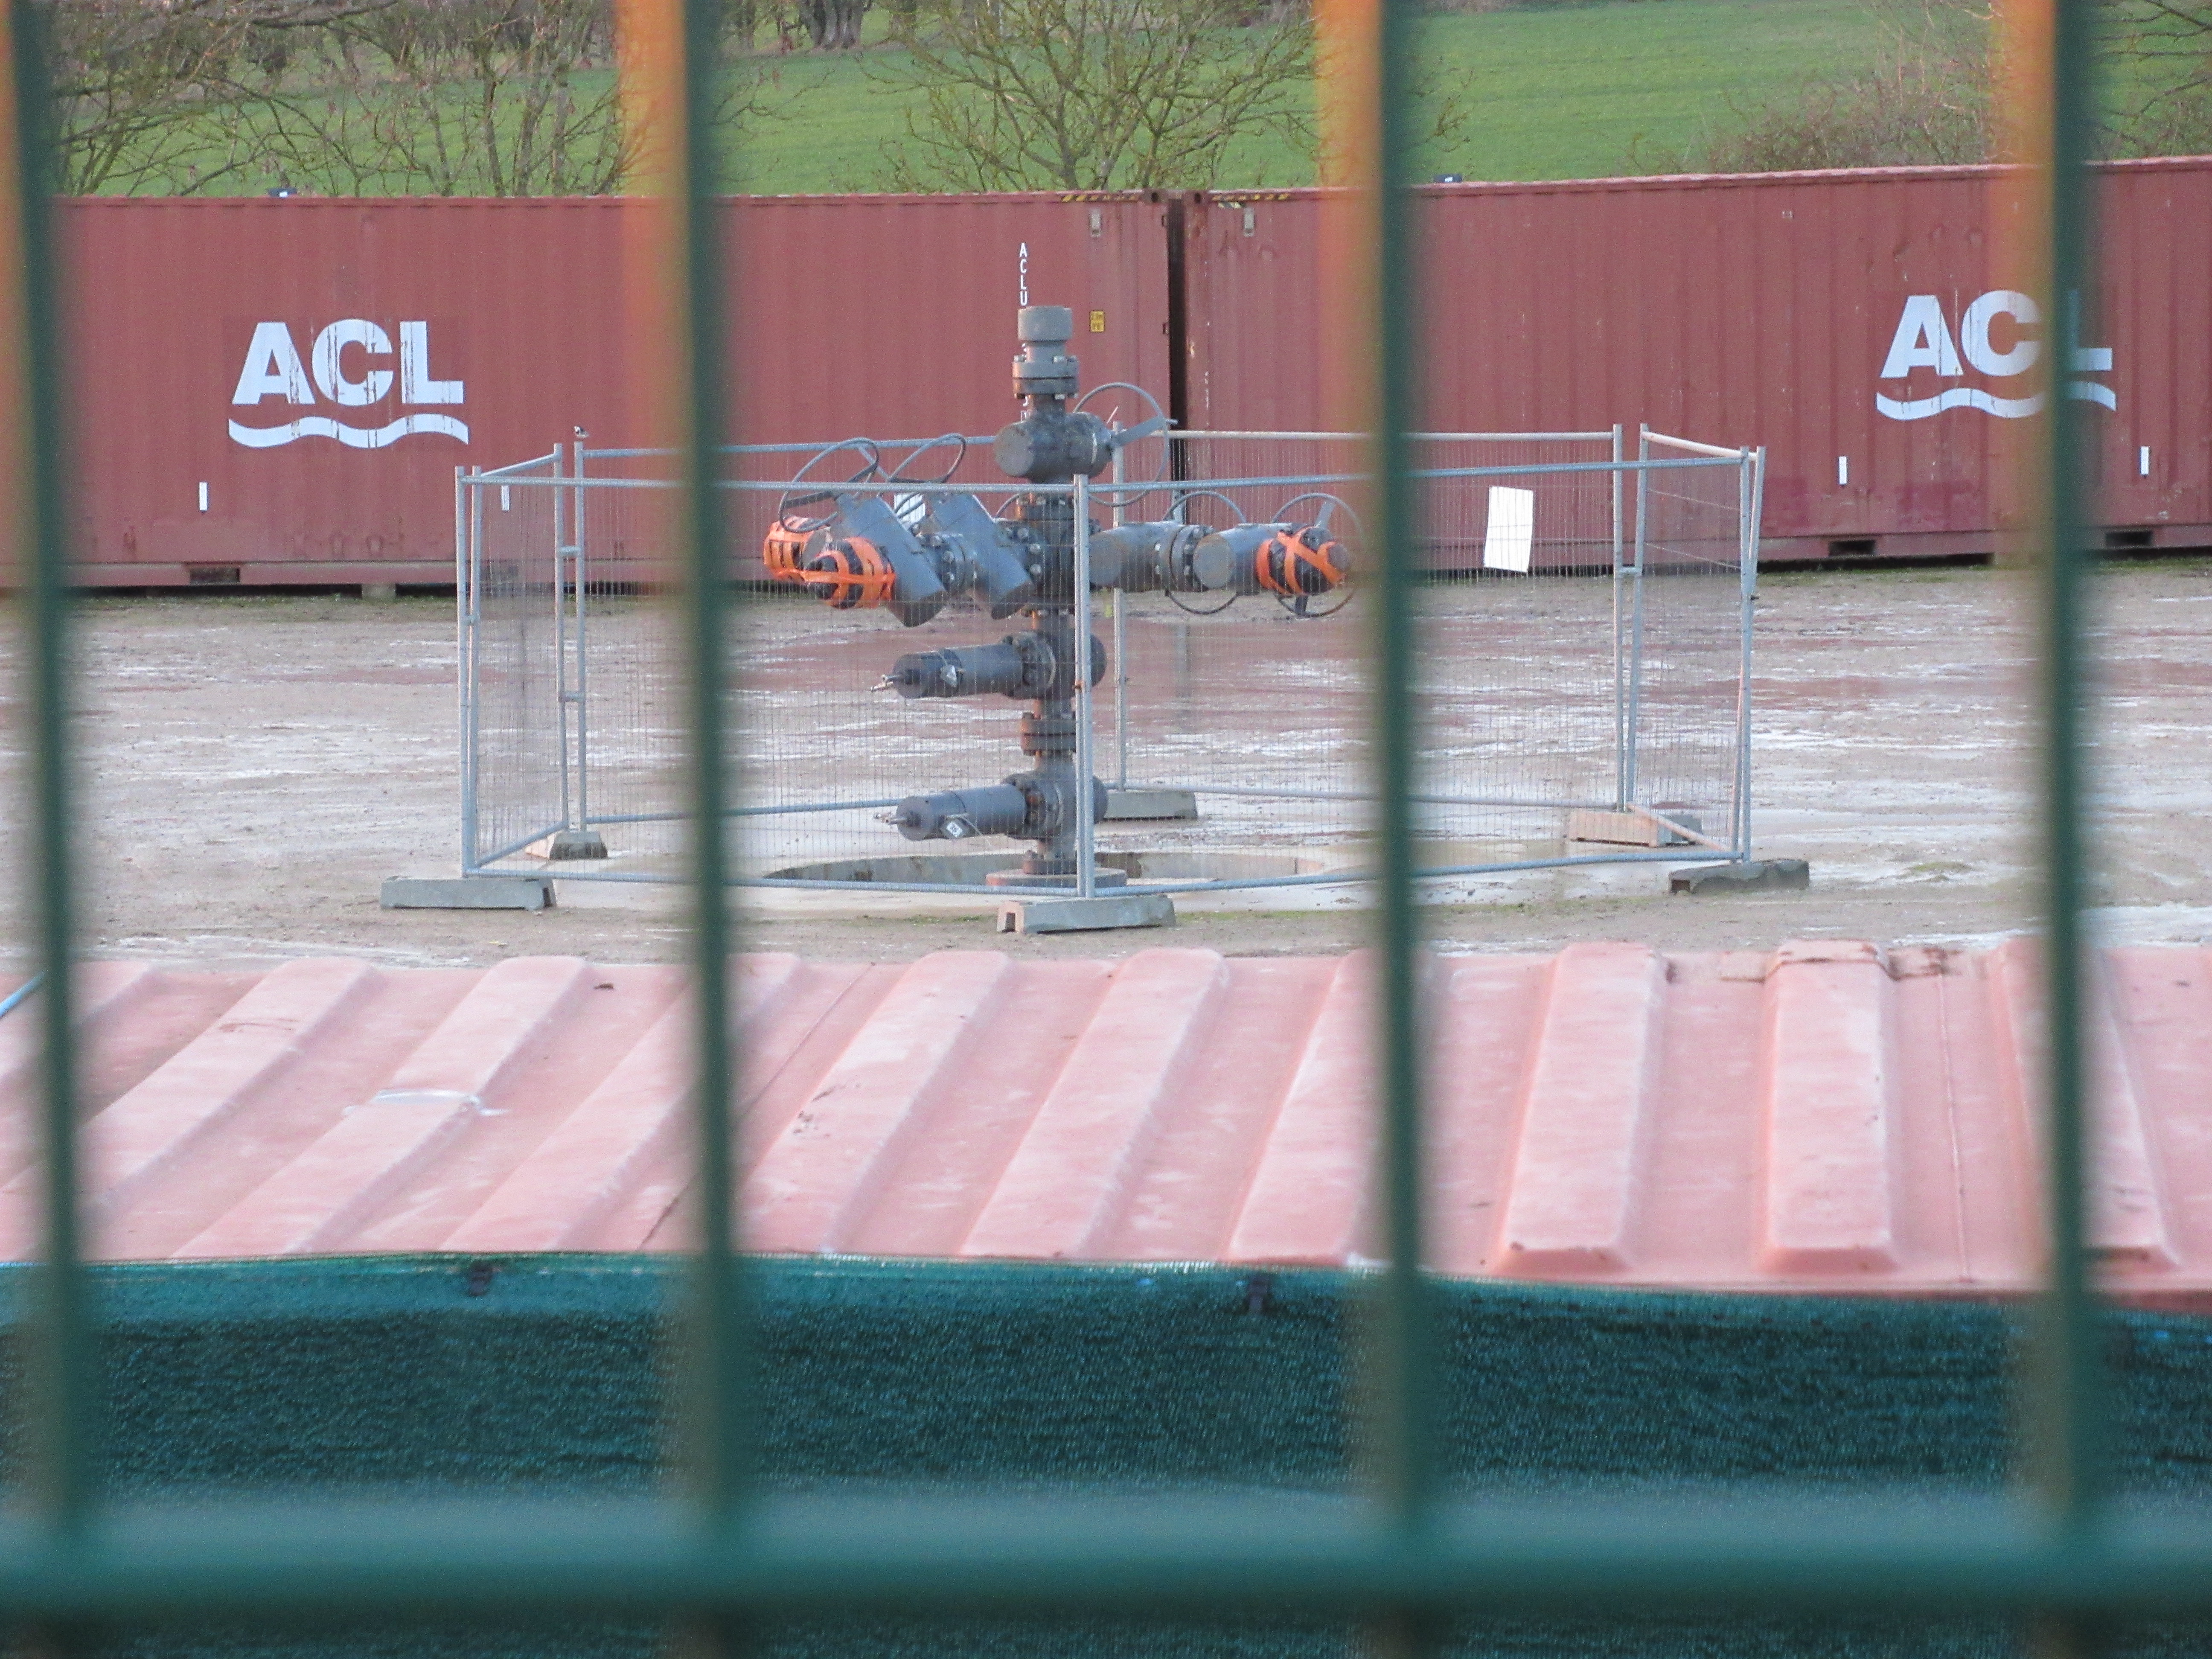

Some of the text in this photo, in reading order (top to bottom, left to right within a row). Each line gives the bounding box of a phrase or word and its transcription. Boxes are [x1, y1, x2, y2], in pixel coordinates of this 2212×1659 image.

[1019, 242, 1027, 306] ACLU
[232, 319, 464, 406] ACL
[1881, 290, 2113, 378] ACL
